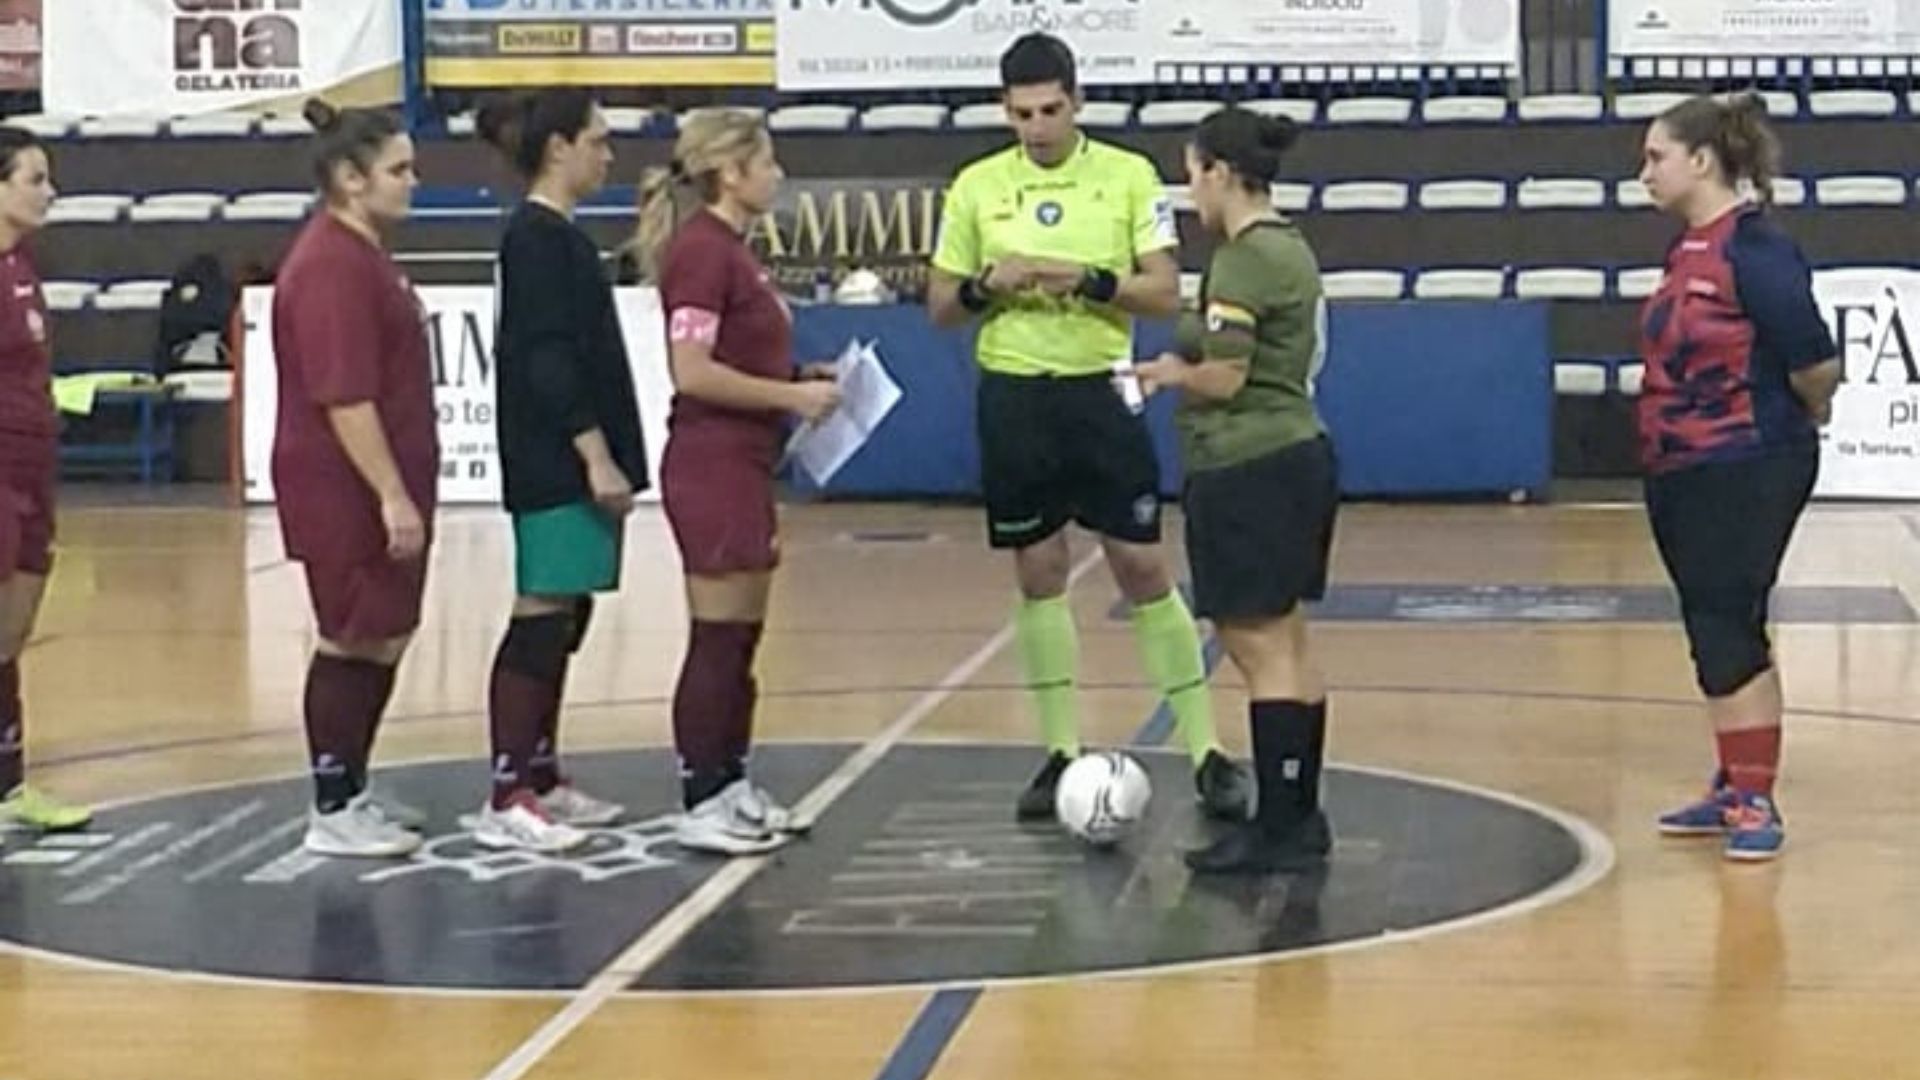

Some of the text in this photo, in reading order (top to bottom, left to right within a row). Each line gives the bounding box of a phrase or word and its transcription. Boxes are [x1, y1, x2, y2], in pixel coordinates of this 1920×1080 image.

[174, 15, 300, 70] na
[175, 74, 300, 91] GELATERIA
[744, 188, 948, 257] AMMI
